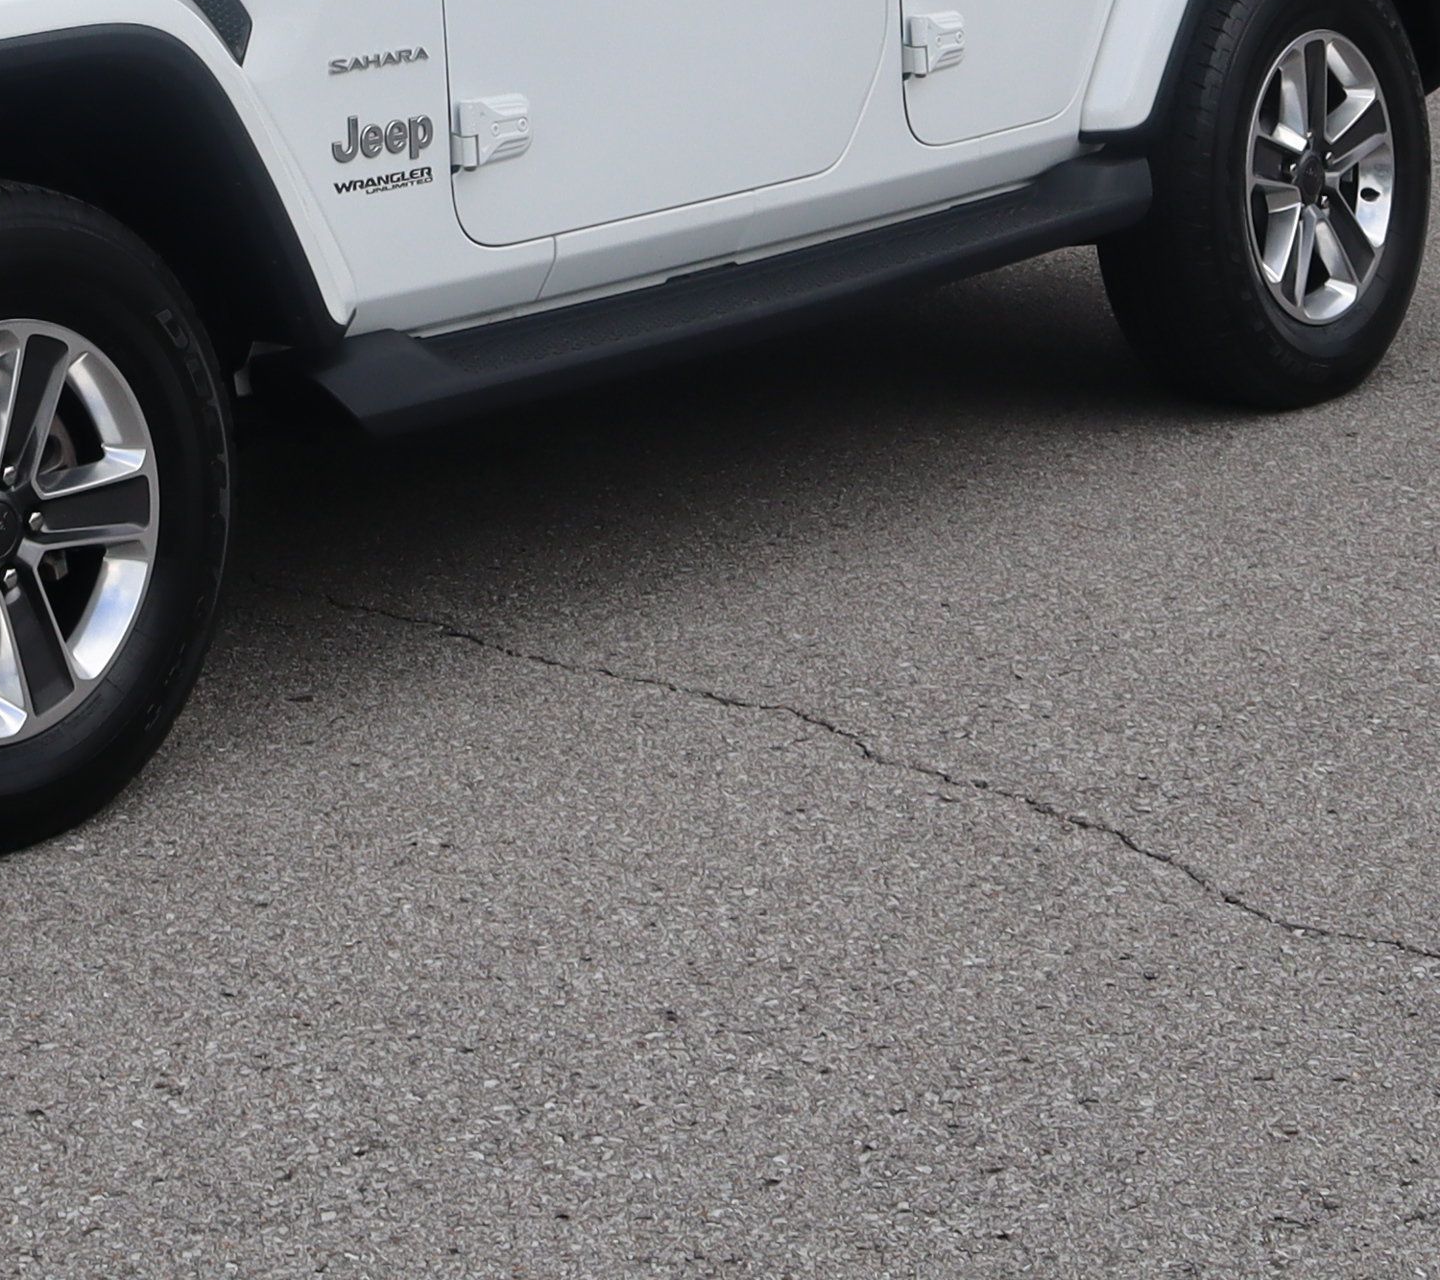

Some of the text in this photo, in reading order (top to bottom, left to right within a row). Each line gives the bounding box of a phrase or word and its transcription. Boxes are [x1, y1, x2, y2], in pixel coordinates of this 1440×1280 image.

[329, 46, 429, 75] SAHARA
[332, 115, 433, 163] Jeep
[334, 166, 432, 194] WRANGLER
[366, 176, 433, 195] UNLIMITED
